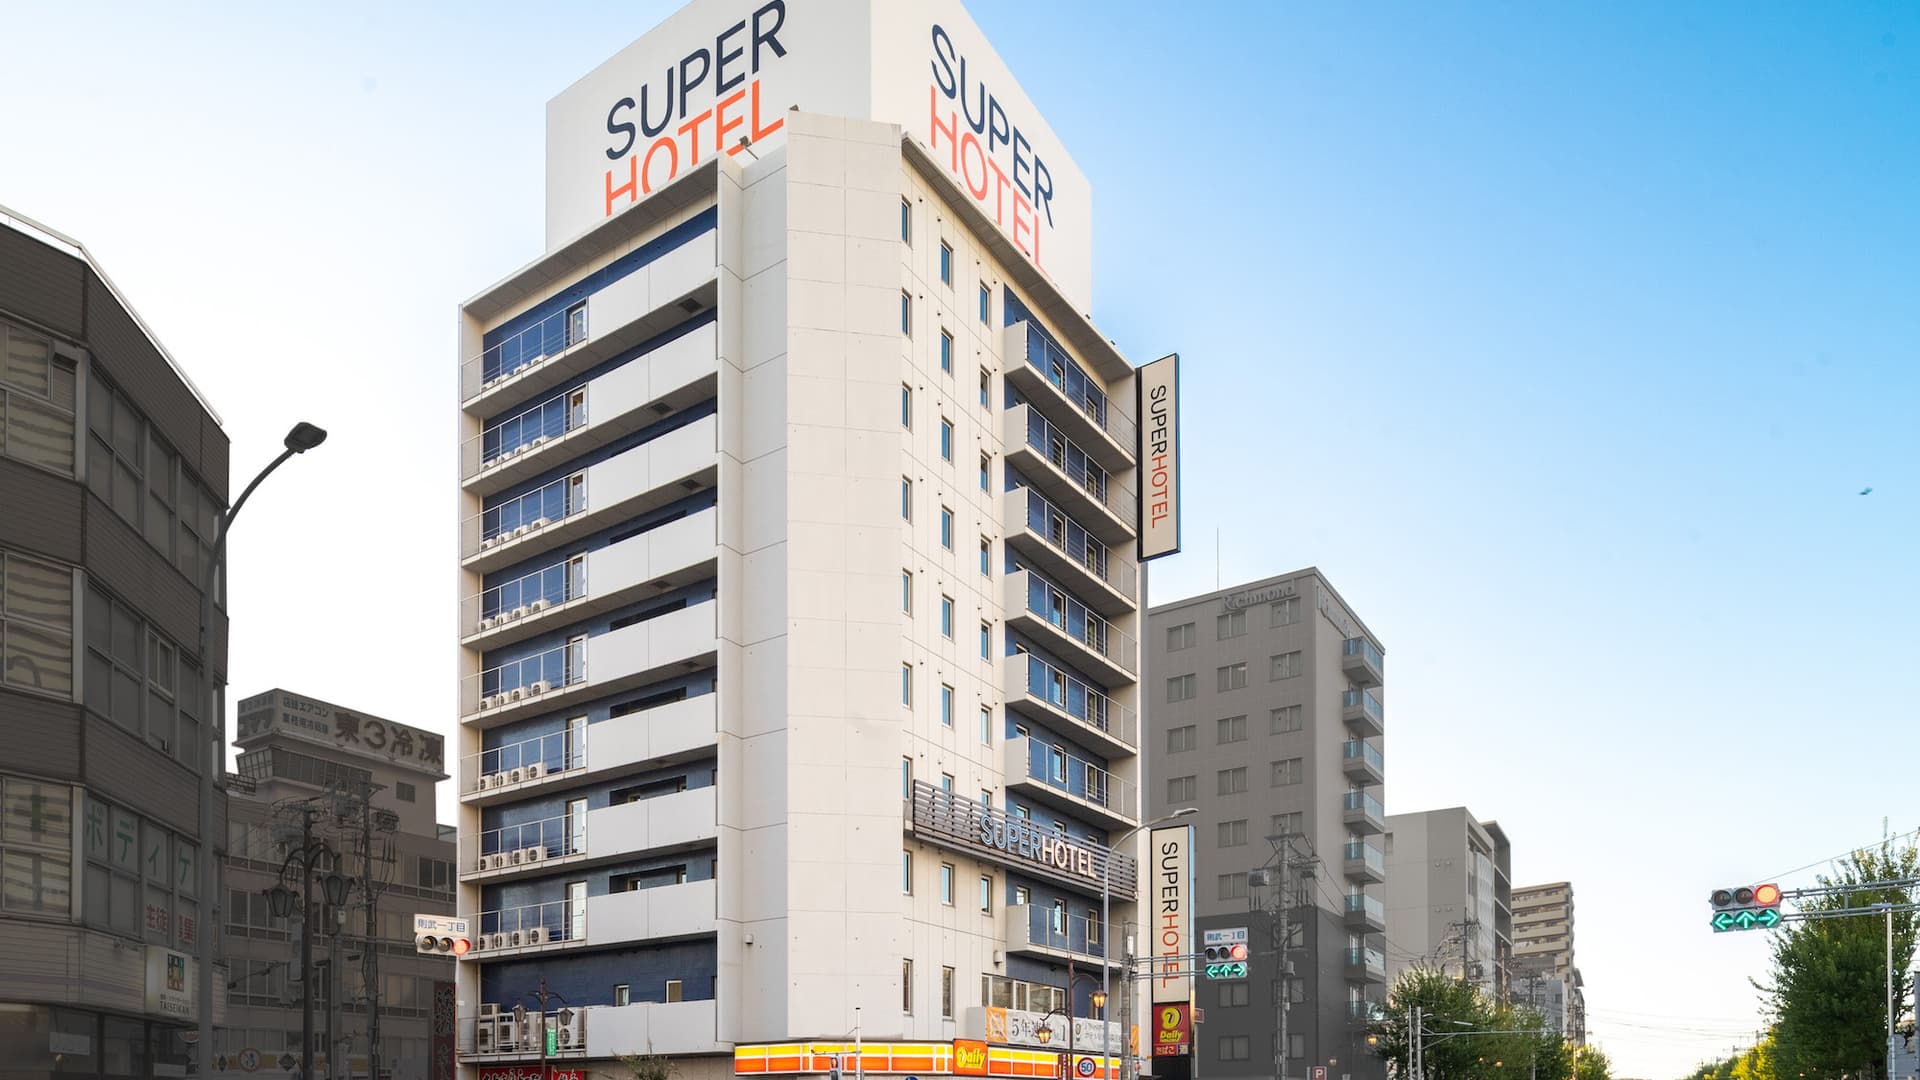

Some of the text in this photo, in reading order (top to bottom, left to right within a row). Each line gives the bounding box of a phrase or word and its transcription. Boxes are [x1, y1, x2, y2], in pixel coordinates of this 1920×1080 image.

[606, 0, 787, 160] SUPER
[931, 24, 1054, 230] SUPER
[605, 79, 784, 217] HOTEL
[930, 84, 1051, 279] HOTEL
[1221, 577, 1297, 613] Richmond
[1160, 1030, 1184, 1042] Daily
[957, 1046, 986, 1068] Daily
[1081, 1062, 1093, 1073] 50
[1315, 1069, 1324, 1079] P
